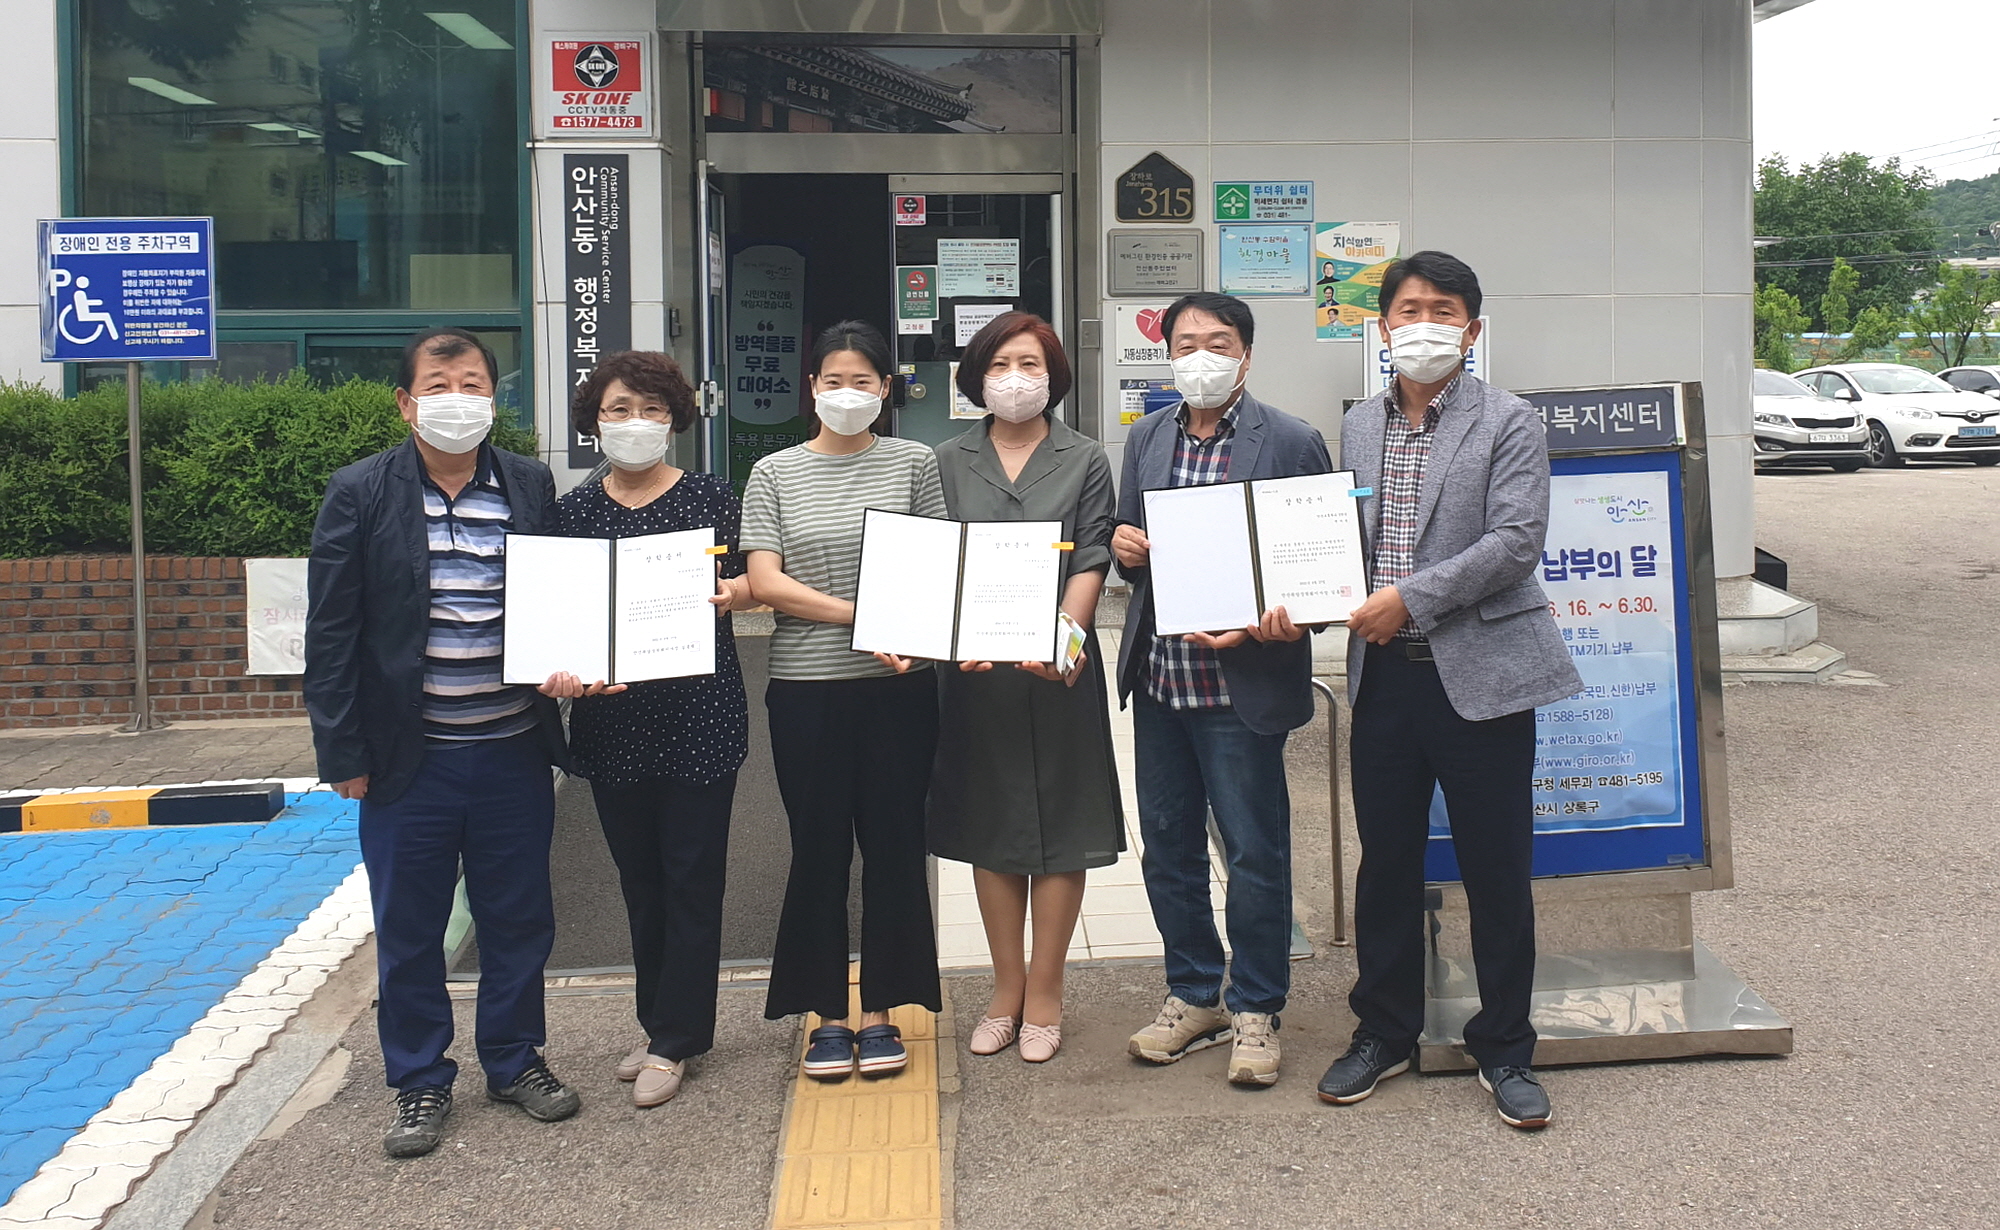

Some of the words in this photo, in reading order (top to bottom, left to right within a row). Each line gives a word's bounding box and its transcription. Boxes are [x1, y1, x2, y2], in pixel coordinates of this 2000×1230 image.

[561, 93, 590, 105] SK
[592, 93, 633, 105] ONE
[573, 117, 635, 127] 1577-4473
[599, 166, 611, 227] Community
[609, 166, 620, 230] Ansan-dong
[1253, 185, 1283, 196] 무더위
[1289, 185, 1308, 195] 쉼터
[571, 166, 599, 254] 안산동
[1137, 187, 1192, 217] 315
[59, 236, 99, 252] 장애인
[105, 235, 132, 251] 전용
[137, 235, 191, 250] 주차구역
[601, 229, 612, 266] Service
[1345, 245, 1385, 257] 아카데미
[160, 289, 166, 297] 수
[602, 269, 612, 304] Center
[744, 290, 767, 300] 시민의
[769, 290, 792, 300] 건강을
[734, 335, 796, 353] 방역물품
[1123, 348, 1164, 361] 자동심장충격기
[744, 356, 780, 373] 무료
[737, 376, 791, 394] 대여소
[762, 433, 799, 448] 분무기
[1606, 498, 1649, 523] 안산
[1541, 548, 1622, 582] 납부의
[1630, 544, 1658, 578] 달
[1568, 599, 1592, 616] 16.
[1618, 596, 1658, 614] 6.30.
[1577, 626, 1600, 640] 또는
[1612, 641, 1633, 655] 납부
[1532, 776, 1555, 791] 구청
[1559, 776, 1593, 790] 세무과
[1609, 771, 1663, 787] 481-5195
[1533, 802, 1558, 816] 산시
[1563, 800, 1600, 815] 상록구
